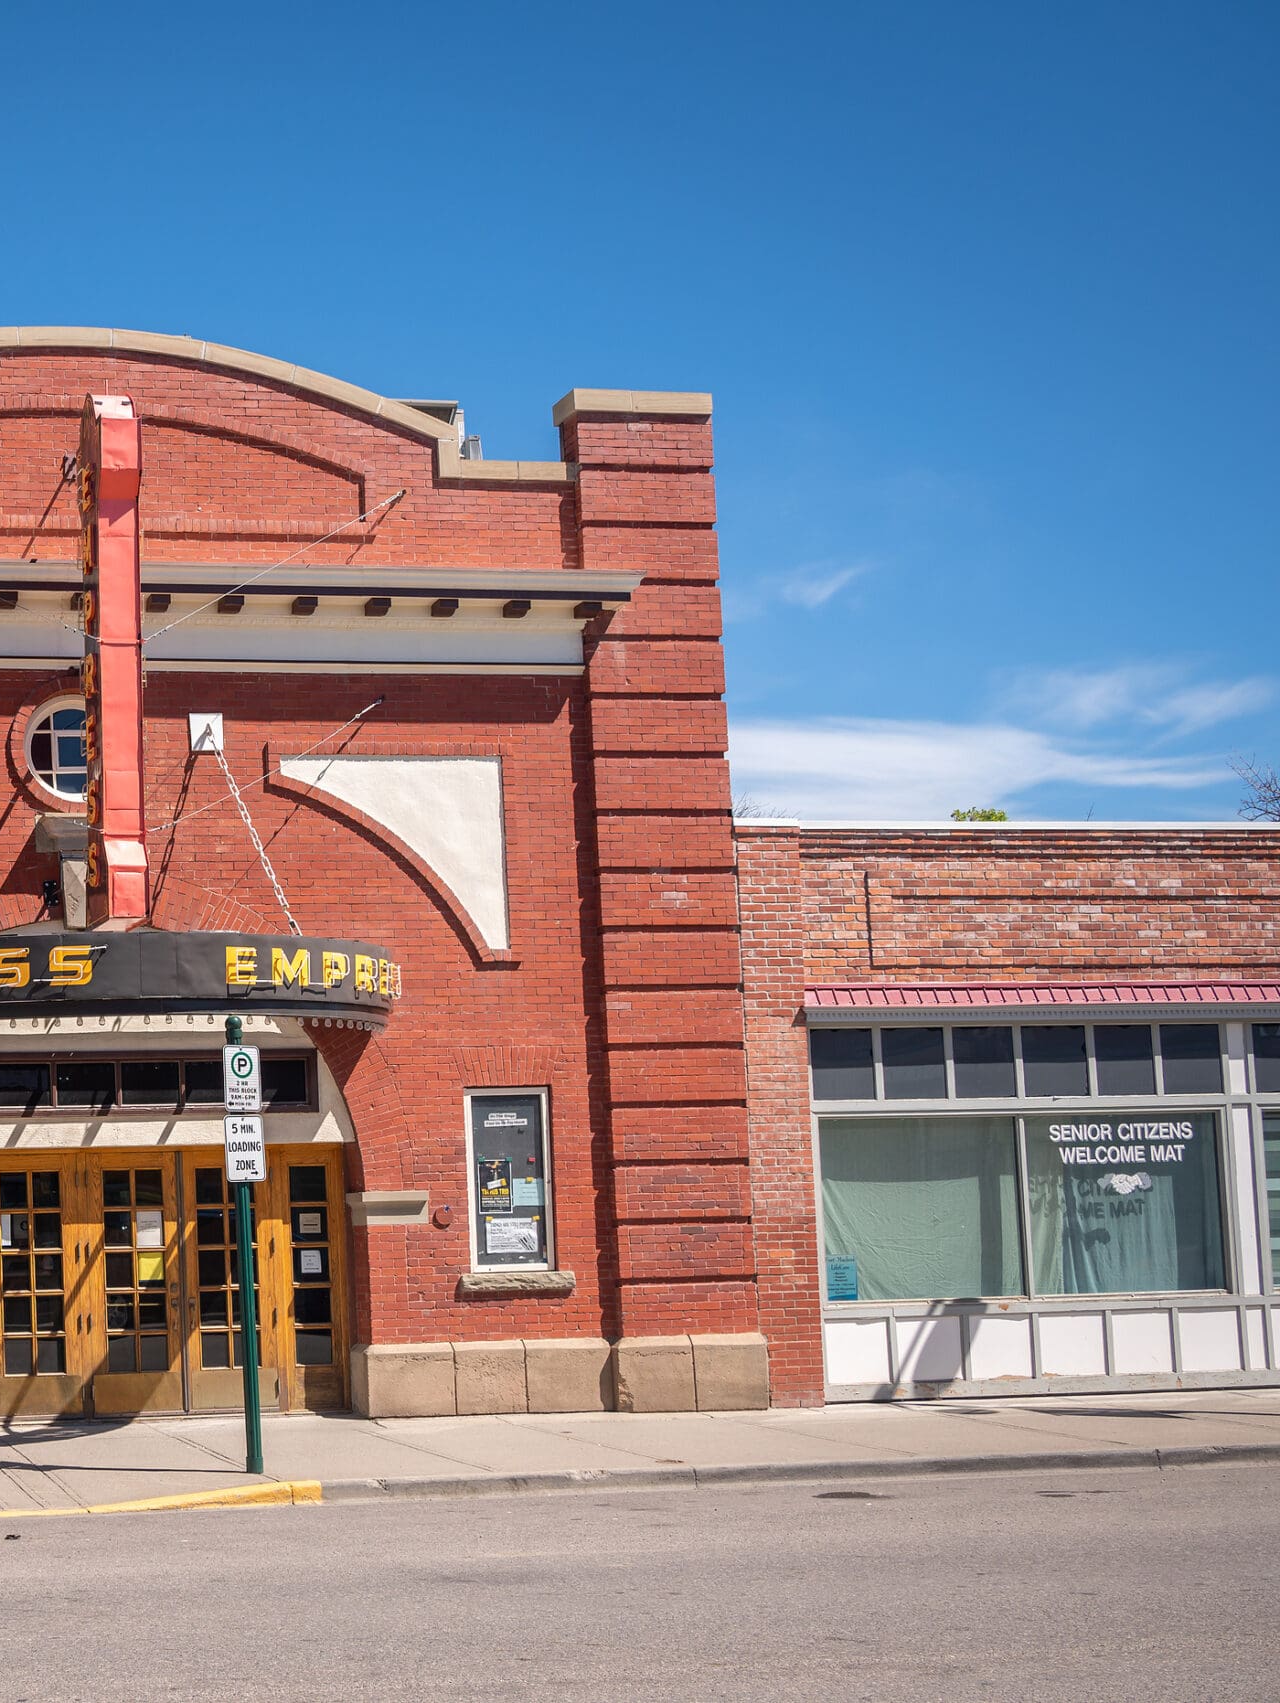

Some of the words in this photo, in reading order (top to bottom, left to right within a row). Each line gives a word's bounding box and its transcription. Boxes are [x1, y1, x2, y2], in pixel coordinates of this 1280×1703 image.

[237, 1058, 247, 1072] P
[232, 1123, 238, 1134] 5
[240, 1124, 256, 1134] MIN.
[1049, 1124, 1112, 1142] SENIOR
[1118, 1122, 1193, 1140] CITIZENS
[228, 1141, 261, 1152] LOADING
[1059, 1146, 1146, 1164] WELCOME
[1150, 1144, 1186, 1162] MAT
[236, 1160, 256, 1171] ZONE
